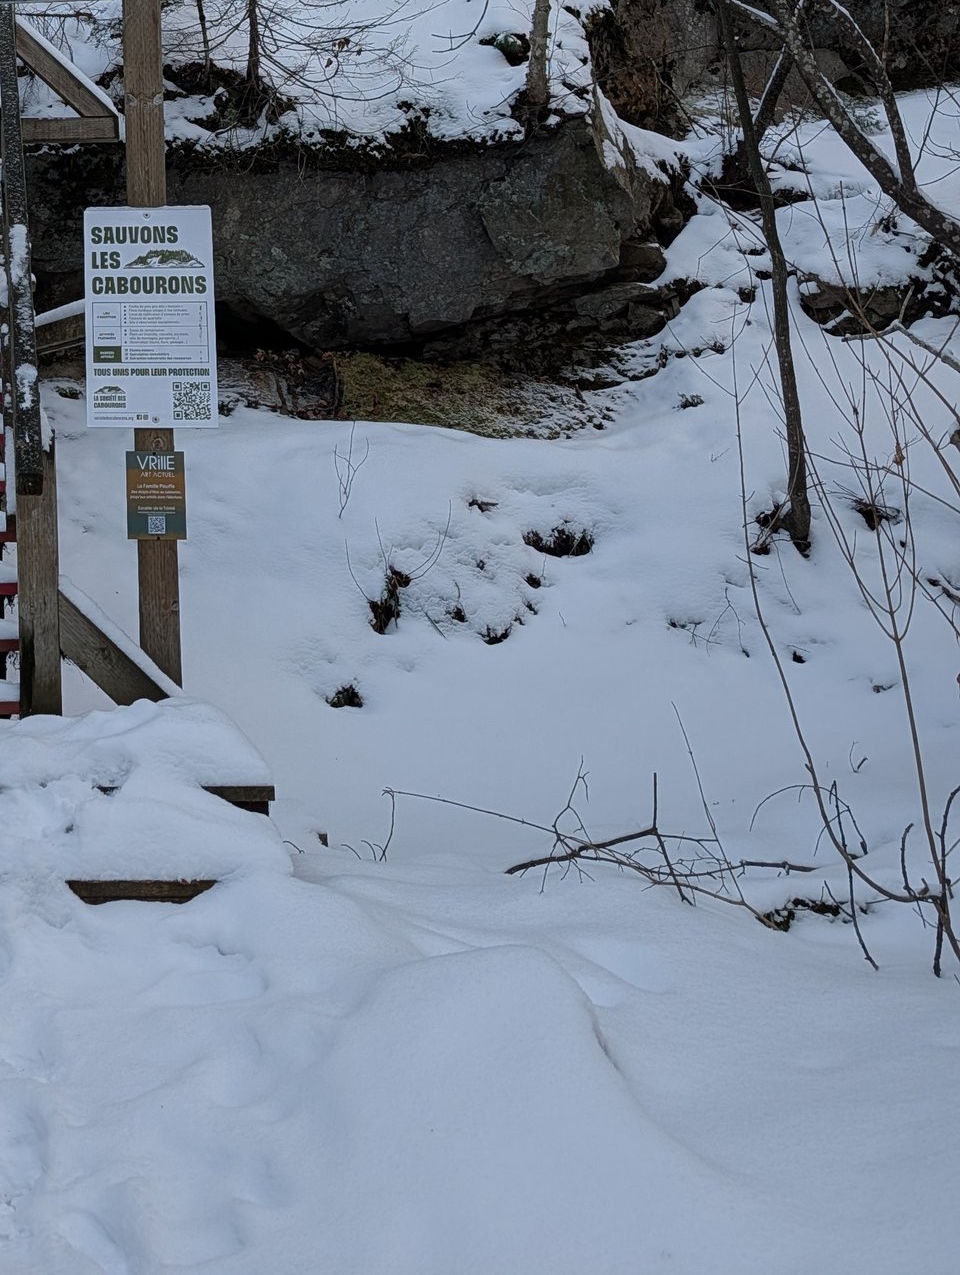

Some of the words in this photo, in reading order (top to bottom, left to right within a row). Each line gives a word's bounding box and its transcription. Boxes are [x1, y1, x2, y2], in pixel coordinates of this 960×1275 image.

[90, 225, 179, 245] SAUVONS
[91, 251, 121, 270] LES
[92, 275, 207, 295] CABOURONS
[93, 368, 112, 377] TOUS
[112, 368, 130, 377] UNIS
[130, 368, 150, 377] POUR
[151, 368, 167, 377] LEUR
[168, 367, 210, 377] PROTECTION
